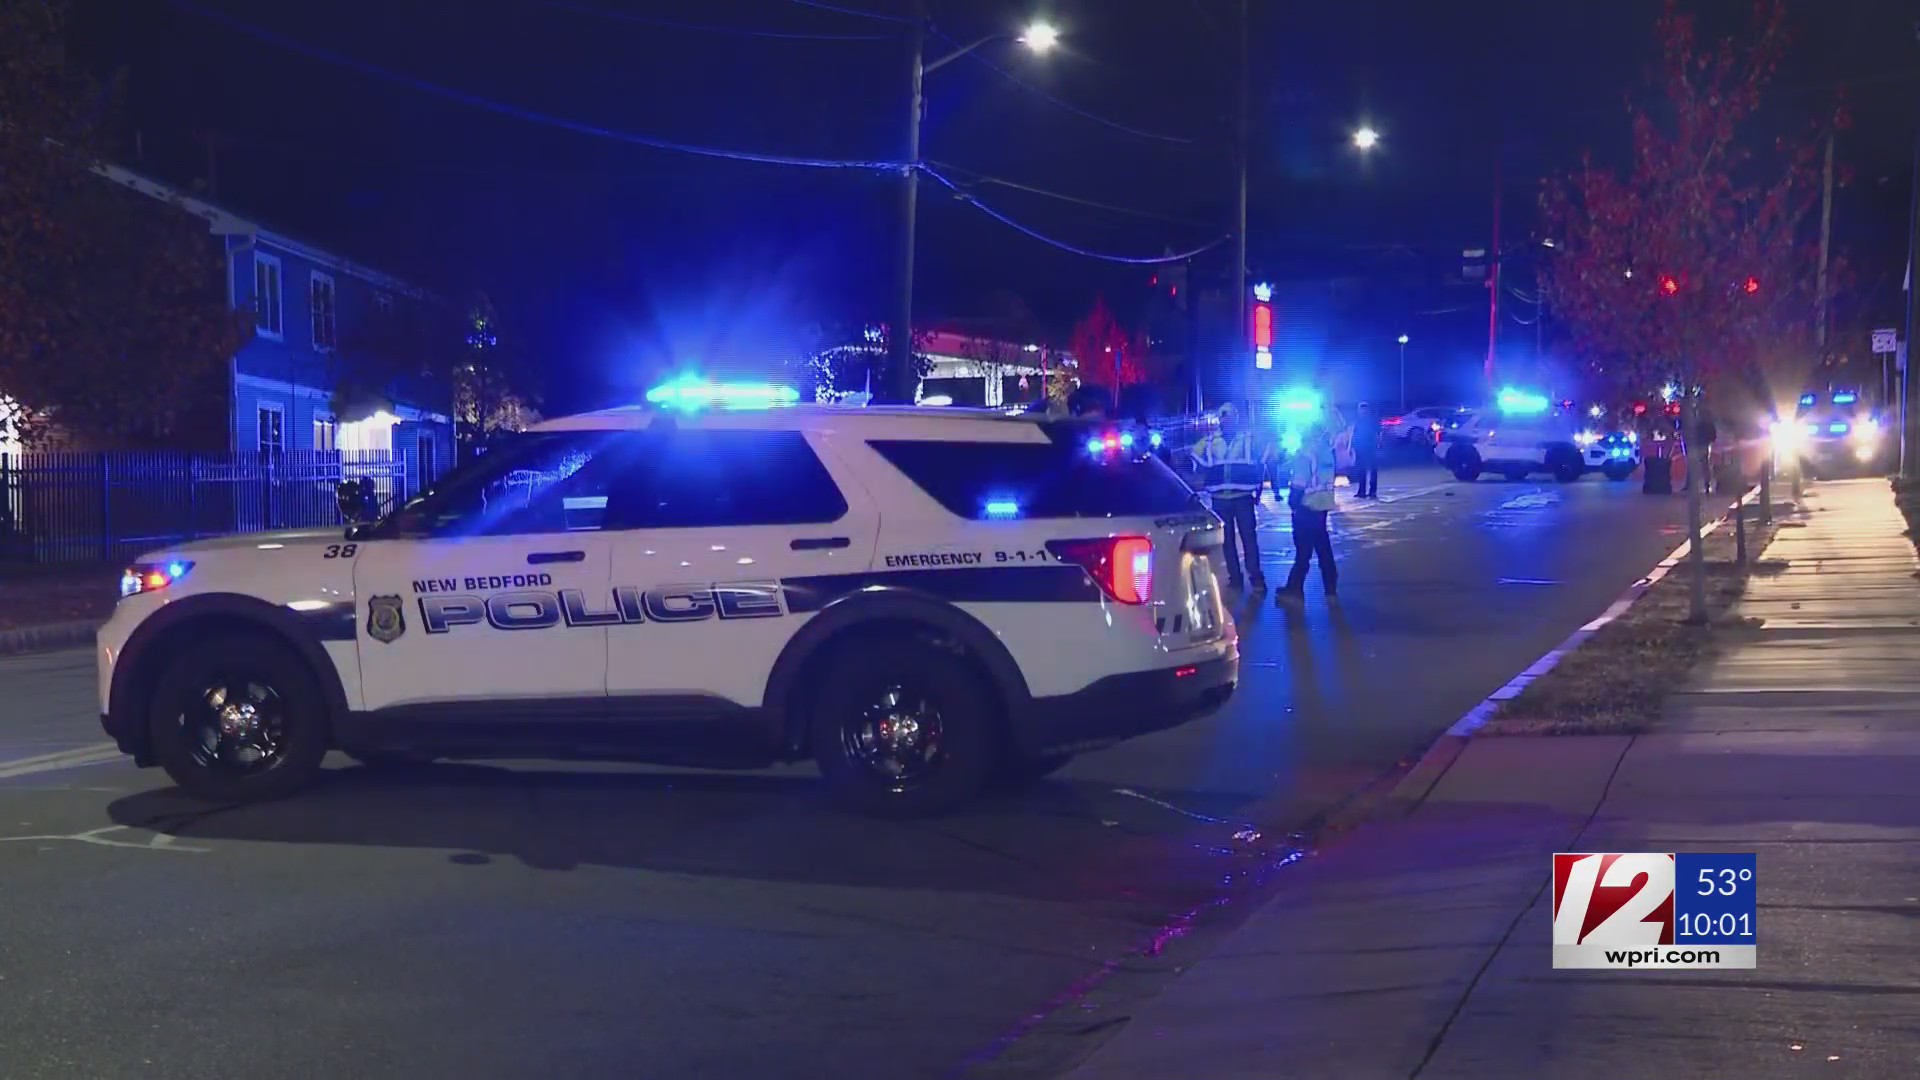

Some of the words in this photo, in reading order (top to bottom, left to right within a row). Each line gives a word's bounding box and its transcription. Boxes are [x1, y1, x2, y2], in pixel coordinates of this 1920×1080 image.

[323, 544, 358, 559] 38
[885, 552, 982, 568] EMERGENCY
[994, 550, 1047, 563] 9-1-1
[412, 579, 457, 594] NEW
[464, 573, 552, 591] BEDFORD
[417, 579, 784, 634] POLICE
